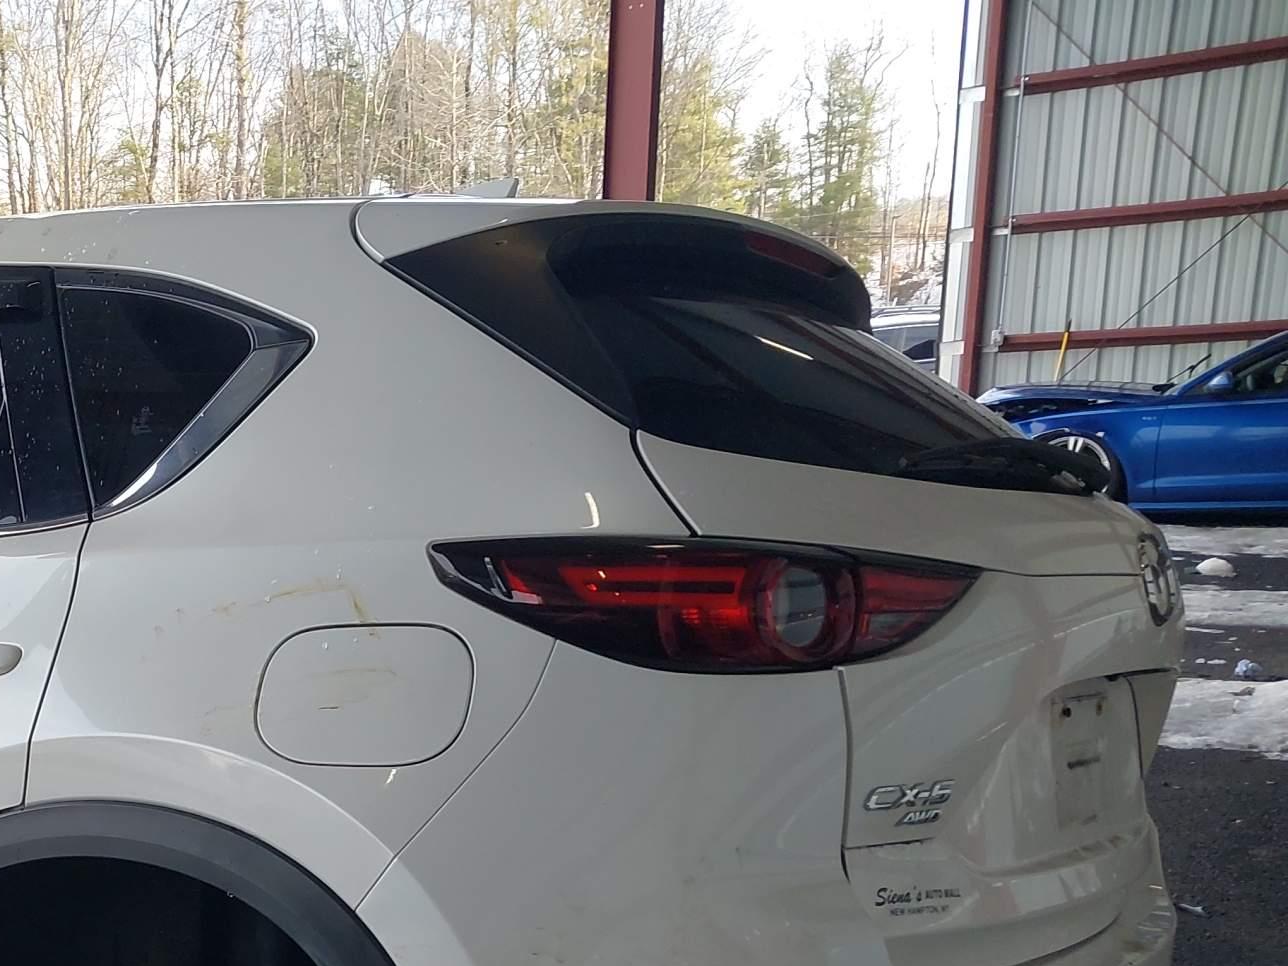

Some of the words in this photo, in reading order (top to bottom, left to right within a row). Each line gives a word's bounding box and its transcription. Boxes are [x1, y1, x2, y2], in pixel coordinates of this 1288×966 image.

[864, 779, 955, 811] CX-5
[895, 808, 942, 826] AWD
[875, 885, 922, 906] Siena's
[925, 889, 943, 899] AUTO
